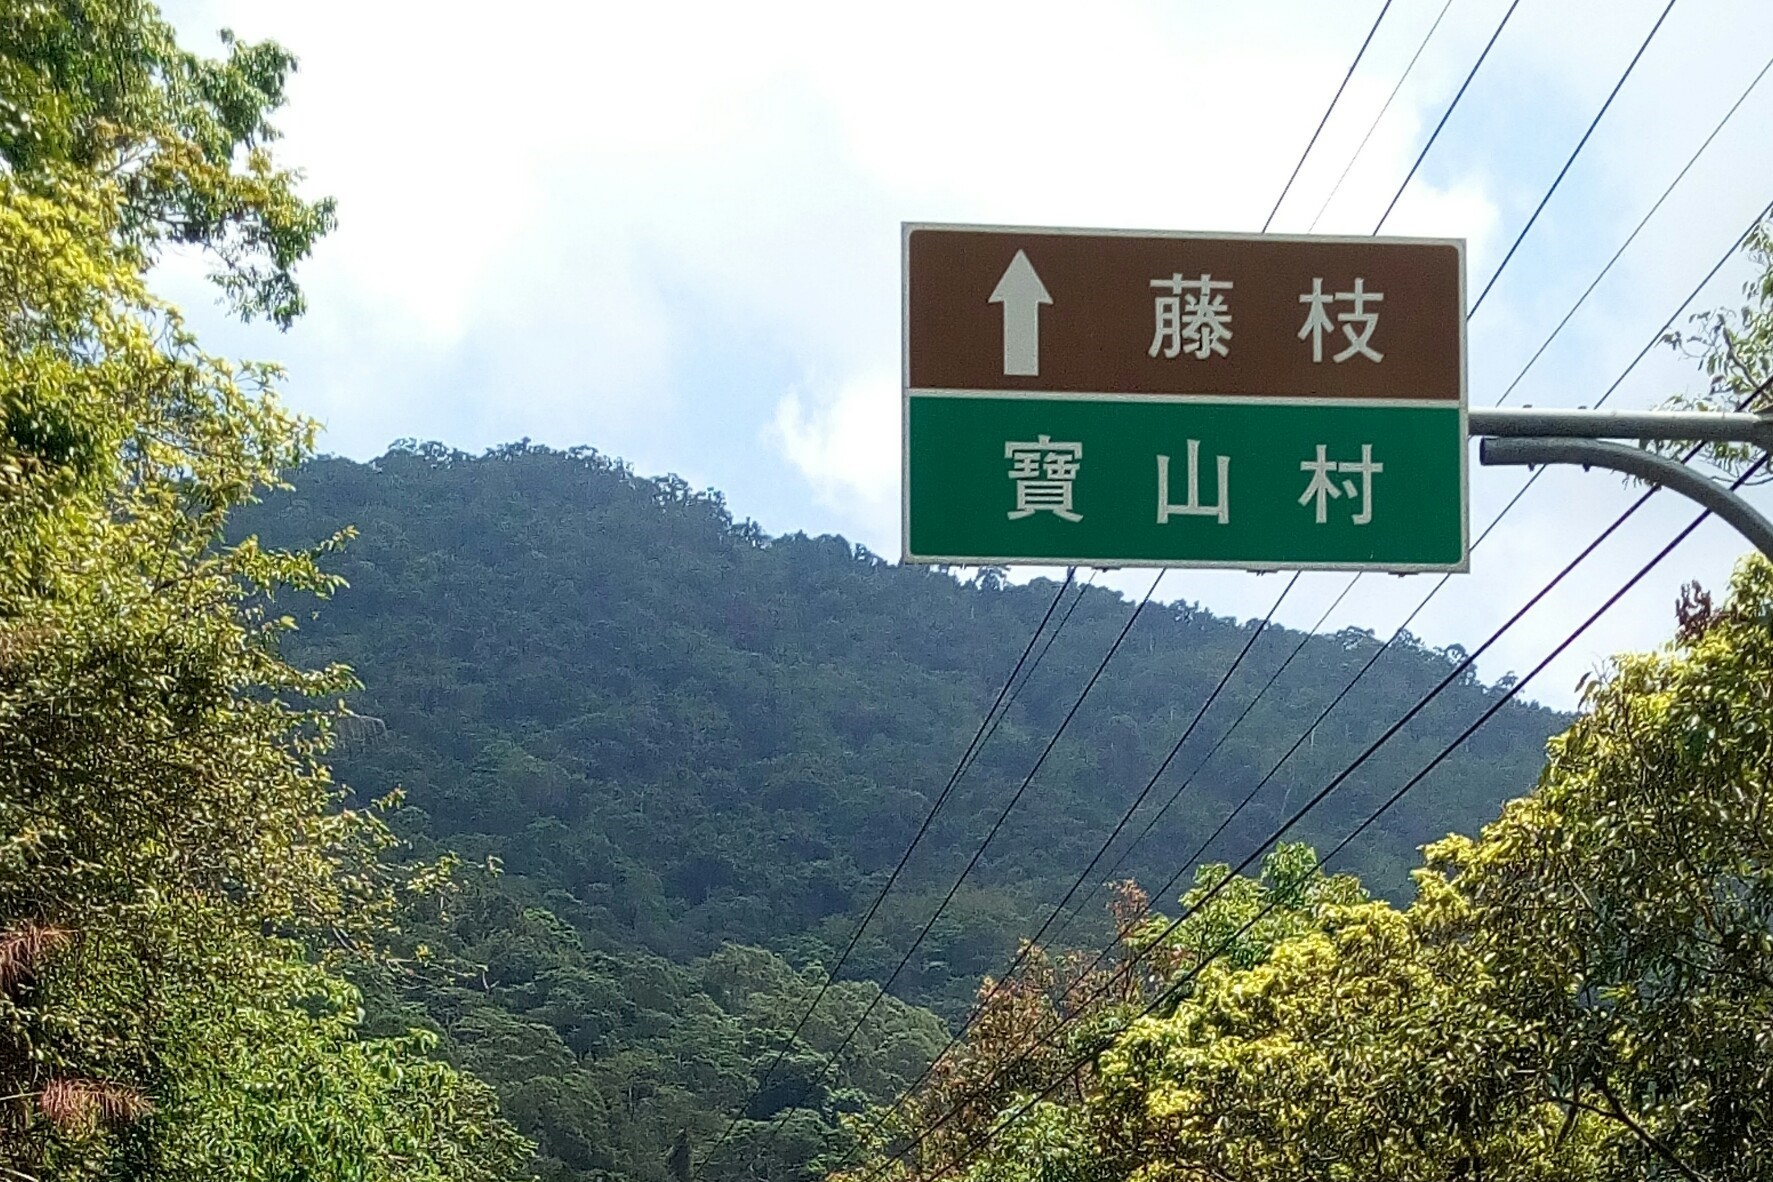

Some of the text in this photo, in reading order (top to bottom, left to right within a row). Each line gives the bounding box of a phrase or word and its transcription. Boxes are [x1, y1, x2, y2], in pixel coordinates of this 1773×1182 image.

[1148, 273, 1384, 363] 藤枝
[1004, 435, 1384, 524] 寶山村
